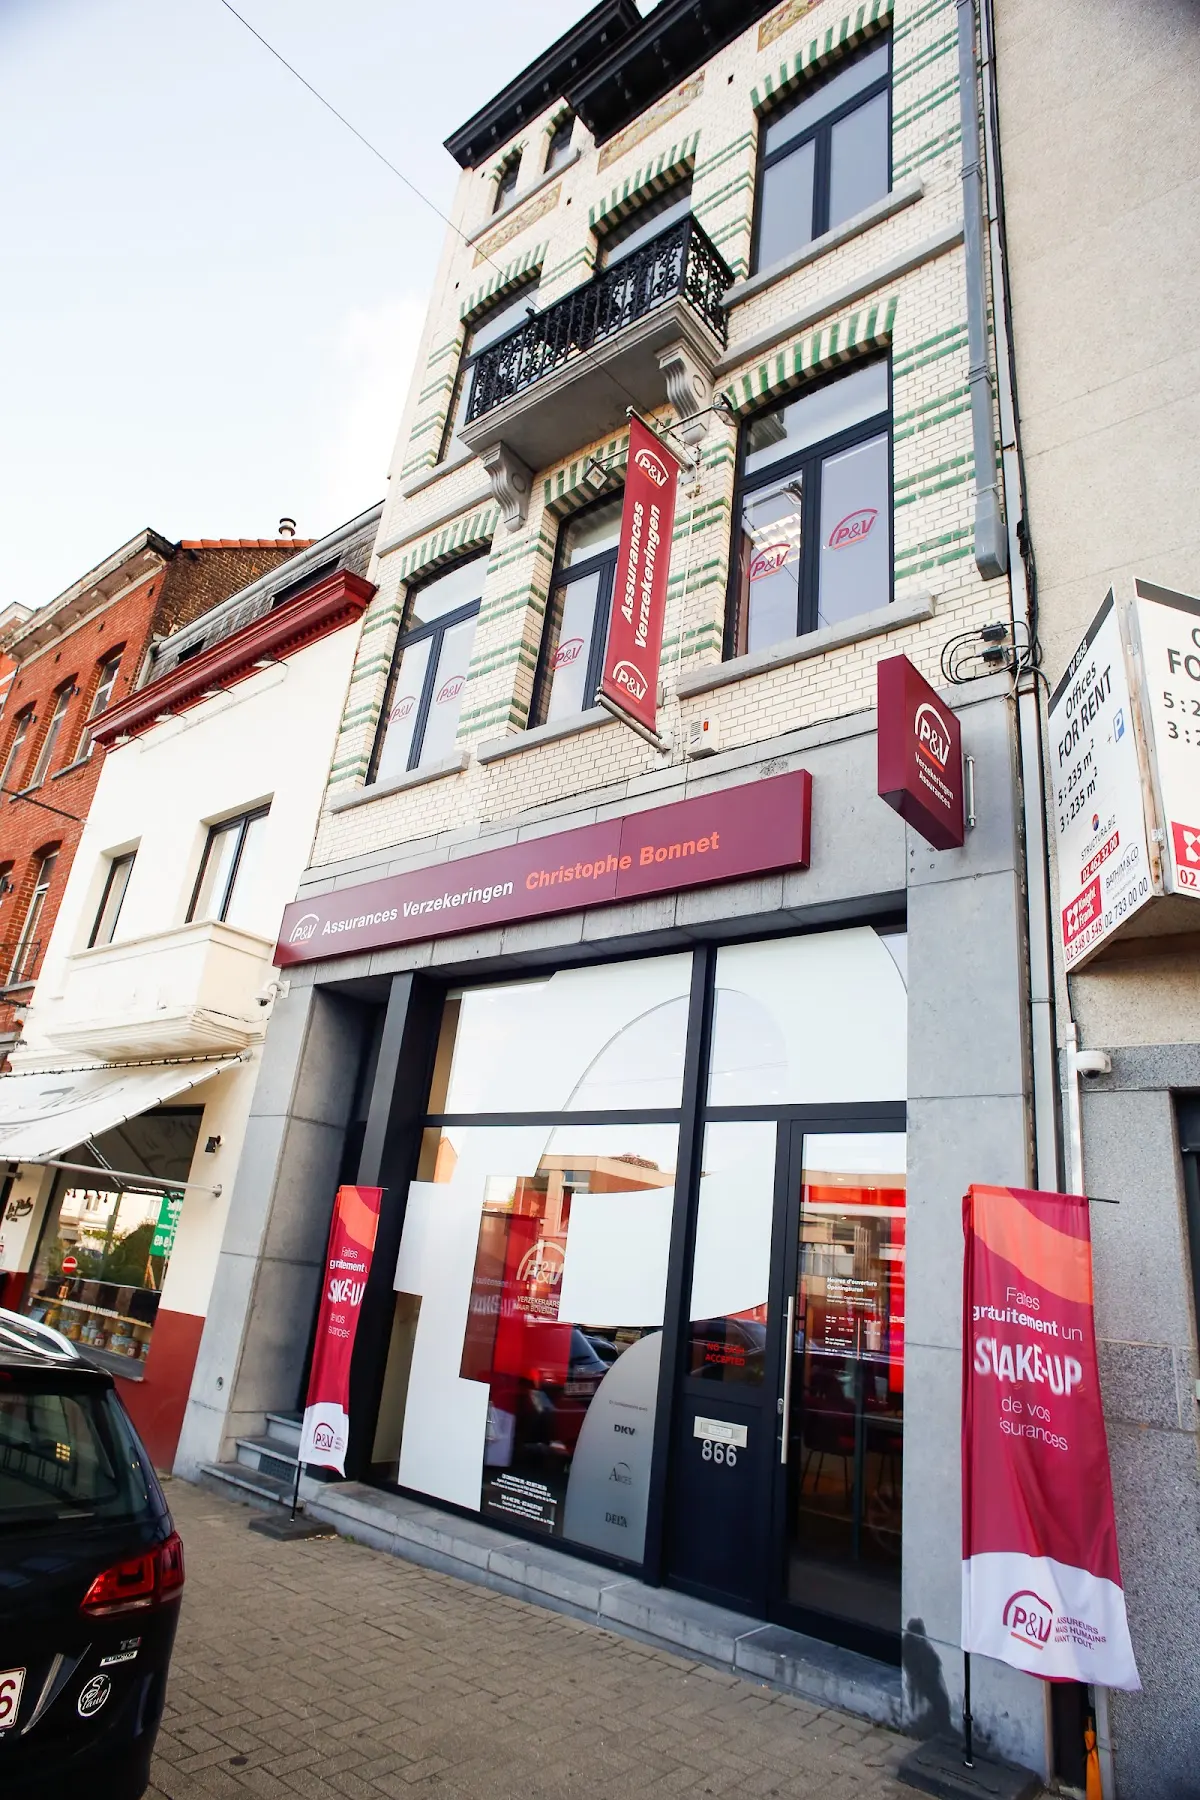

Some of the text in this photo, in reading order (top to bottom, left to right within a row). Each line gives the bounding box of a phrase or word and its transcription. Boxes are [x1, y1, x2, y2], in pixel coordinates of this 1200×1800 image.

[638, 458, 667, 487] P&V
[836, 516, 875, 544] P&V
[620, 501, 644, 625] Assurances
[634, 504, 661, 649] Verzekeringen
[752, 551, 789, 577] P&V
[617, 673, 646, 701] P&V
[1066, 661, 1096, 719] Offices
[1058, 665, 1111, 768] FOR RENT
[919, 716, 950, 766] P&V
[915, 752, 954, 800] Verzekeringen
[919, 770, 951, 809] Assurances
[293, 832, 720, 942] P&V Assurances Verzekeringen Christophe Bonnet
[1104, 877, 1148, 929] 02 733 00 00
[1066, 946, 1073, 962] 02
[707, 1342, 720, 1351] NO
[1061, 1328, 1083, 1342] un
[705, 1353, 745, 1366] ACCEPTED
[1001, 1396, 1051, 1423] de vos
[316, 1433, 333, 1448] P&V
[614, 1424, 636, 1436] DKV
[701, 1440, 737, 1467] 866
[1012, 1605, 1052, 1643] P&V
[1069, 1626, 1107, 1643] HUMAINS
[0, 1679, 16, 1719] 6
